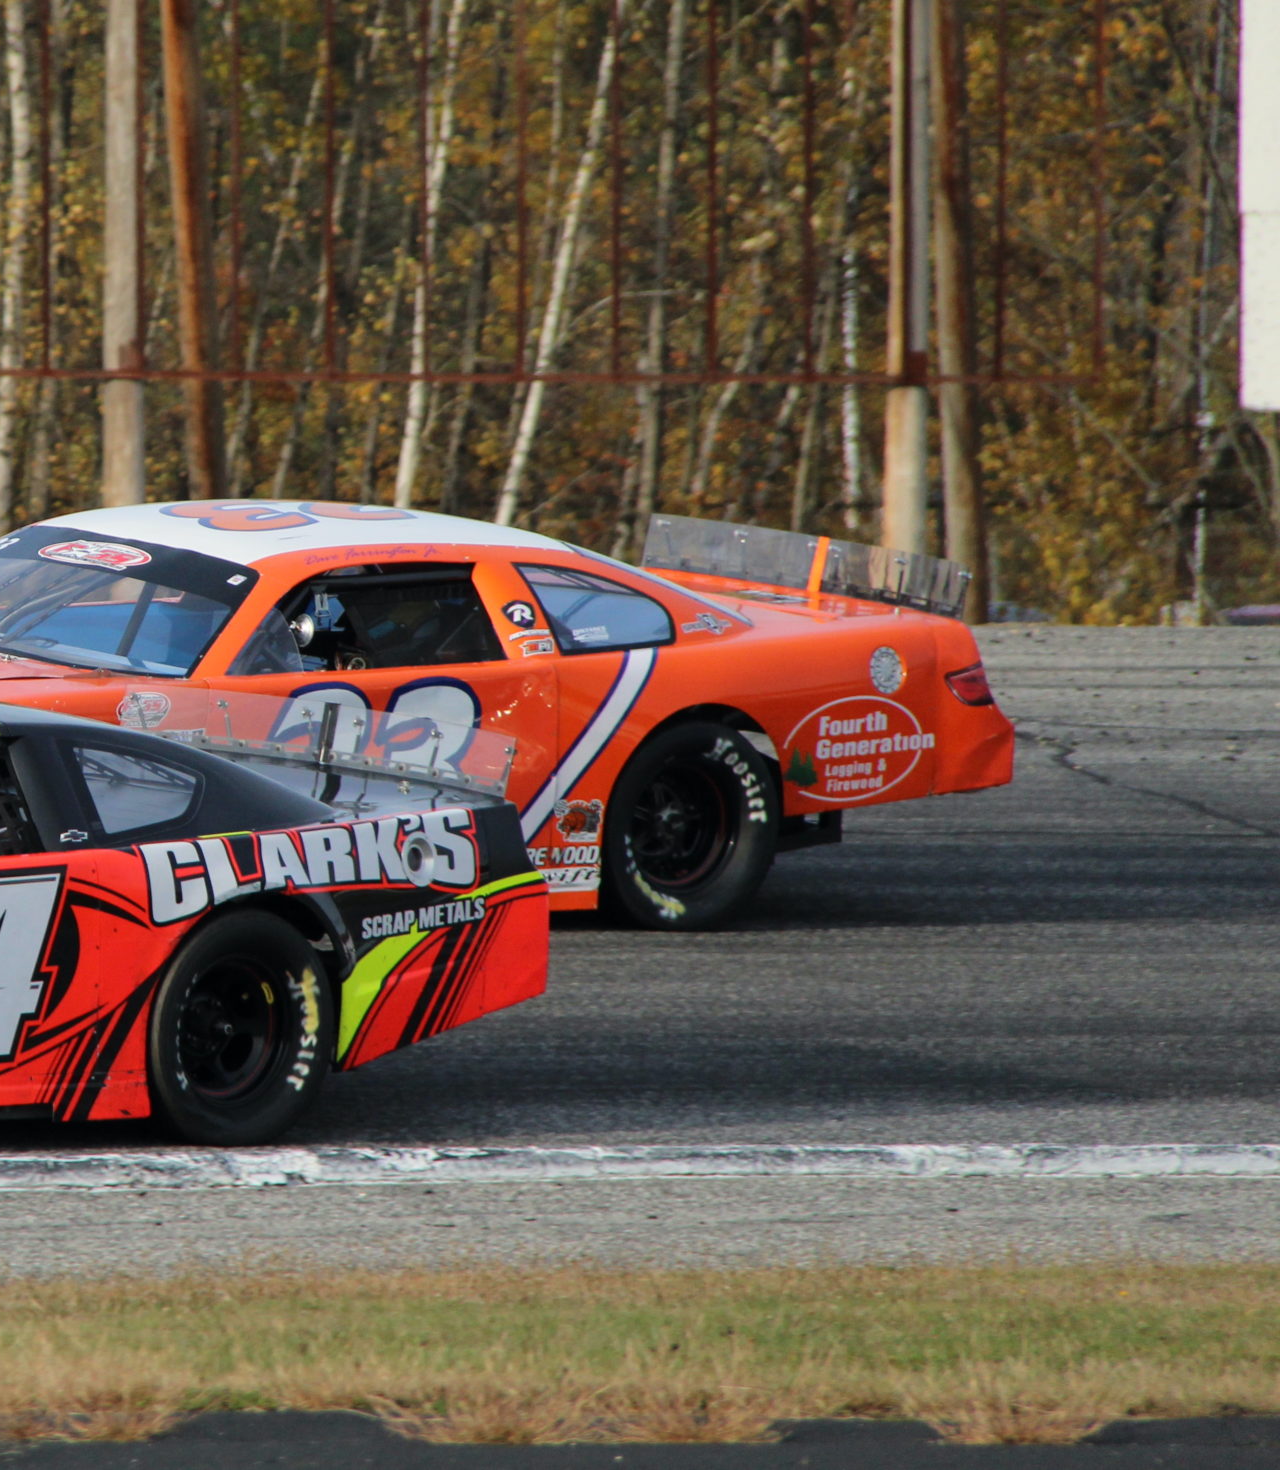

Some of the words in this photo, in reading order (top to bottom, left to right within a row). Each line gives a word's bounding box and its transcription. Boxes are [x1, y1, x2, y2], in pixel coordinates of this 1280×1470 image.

[818, 710, 888, 737] Fourth
[815, 732, 935, 760] Generation
[824, 761, 873, 778] Logging
[876, 757, 887, 772] &
[825, 775, 884, 793] Firewood
[140, 807, 477, 924] CLARK'S
[543, 868, 597, 885] wift
[361, 913, 416, 941] SCRAP
[417, 897, 486, 930] METALS
